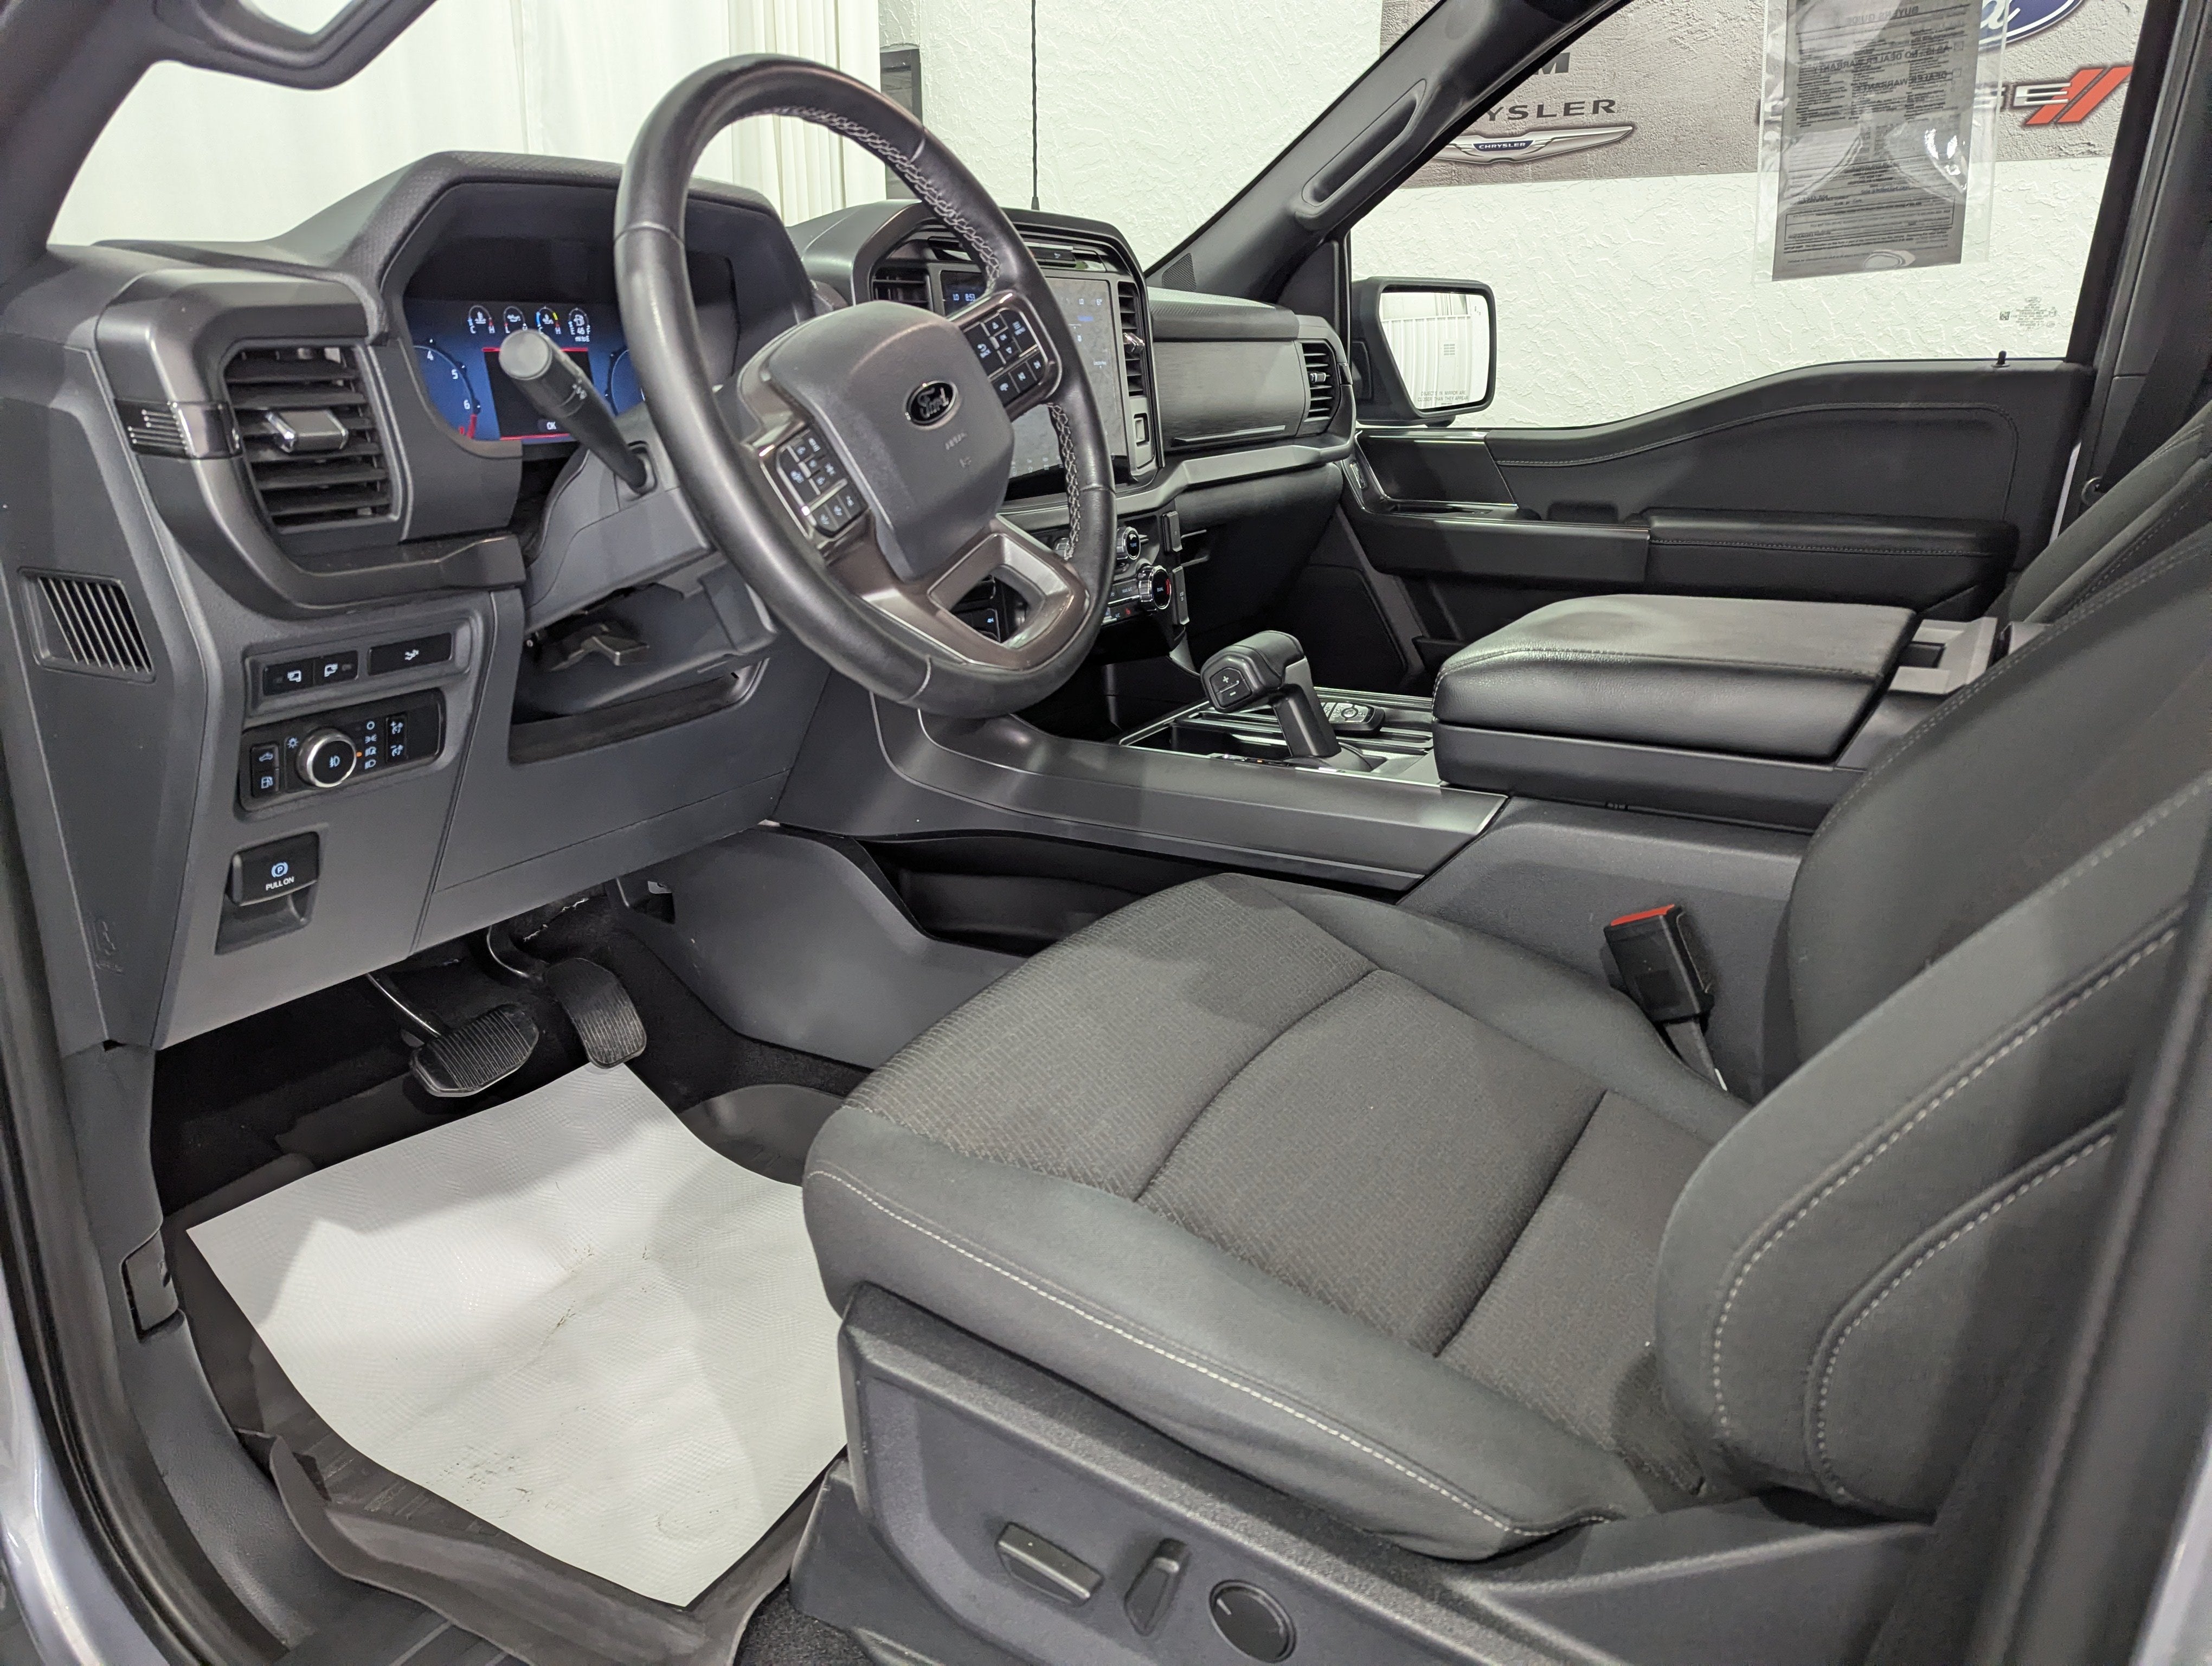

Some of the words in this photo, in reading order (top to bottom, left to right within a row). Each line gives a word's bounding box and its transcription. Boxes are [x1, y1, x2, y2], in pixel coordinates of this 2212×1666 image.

[1486, 99, 1616, 121] YSLER
[427, 350, 434, 361] 4
[451, 369, 458, 379] 5
[464, 399, 471, 410] 6
[265, 880, 282, 891] PULL
[283, 876, 294, 885] ON
